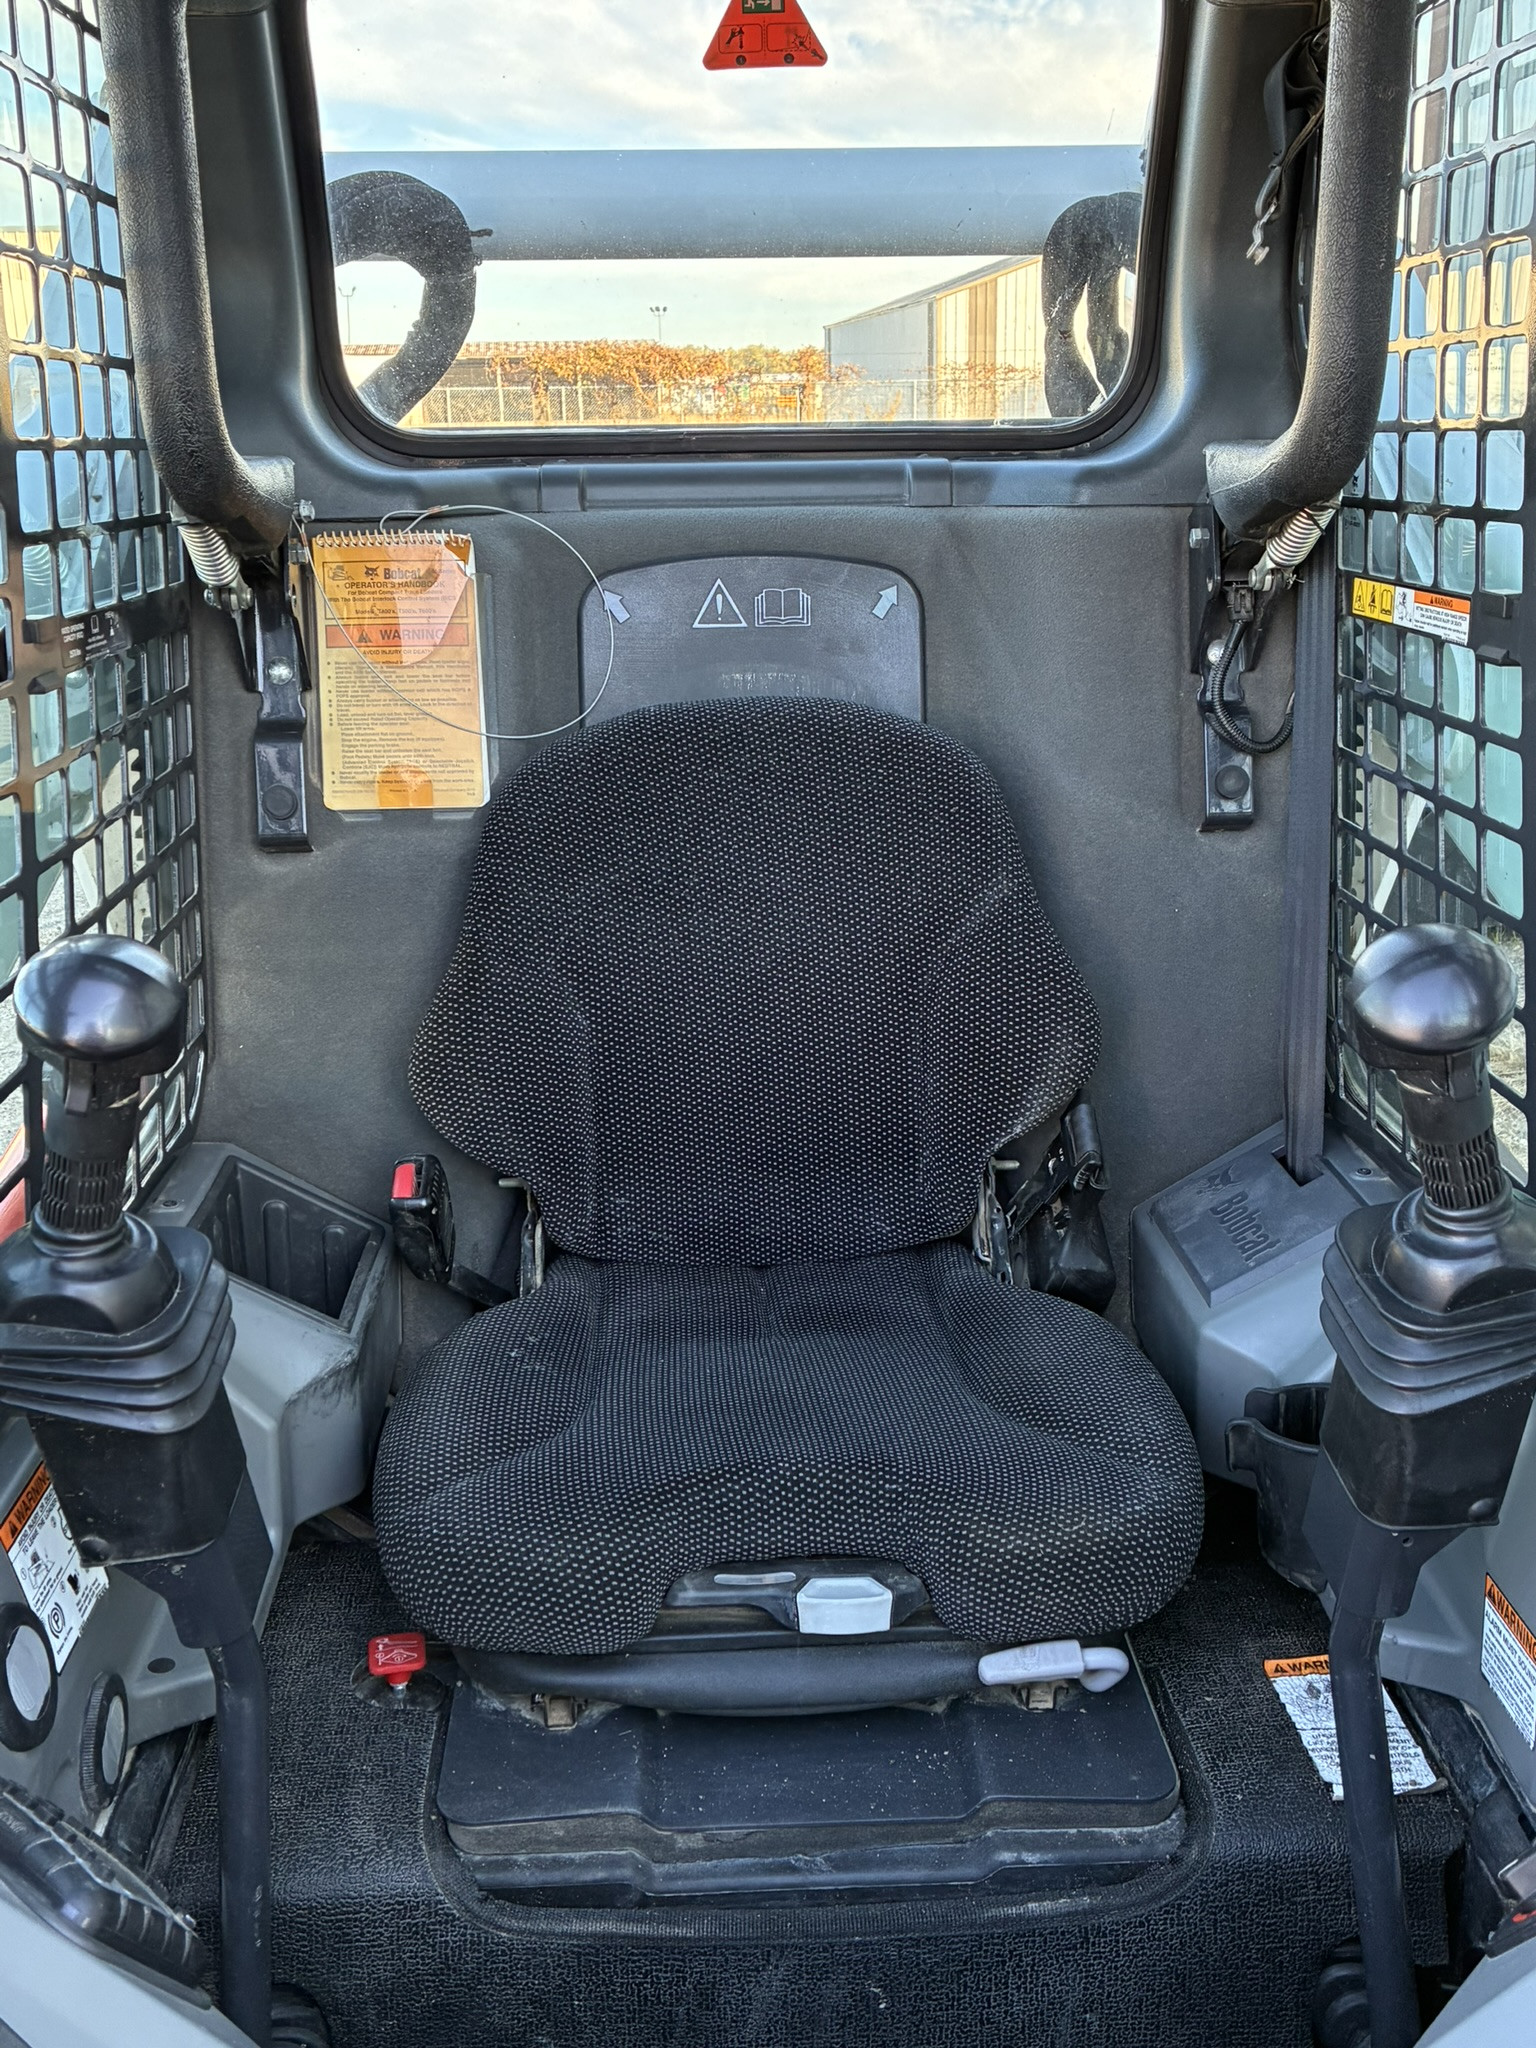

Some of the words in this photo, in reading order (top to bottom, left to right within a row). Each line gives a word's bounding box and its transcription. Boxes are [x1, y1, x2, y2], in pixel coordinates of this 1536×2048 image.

[383, 568, 422, 580] Bobcat
[380, 628, 444, 640] WARNING
[1209, 1190, 1282, 1263] Bobcat
[1486, 1610, 1502, 1638] ALARM
[1503, 1634, 1517, 1658] MUST
[1287, 1660, 1329, 1672] WARN
